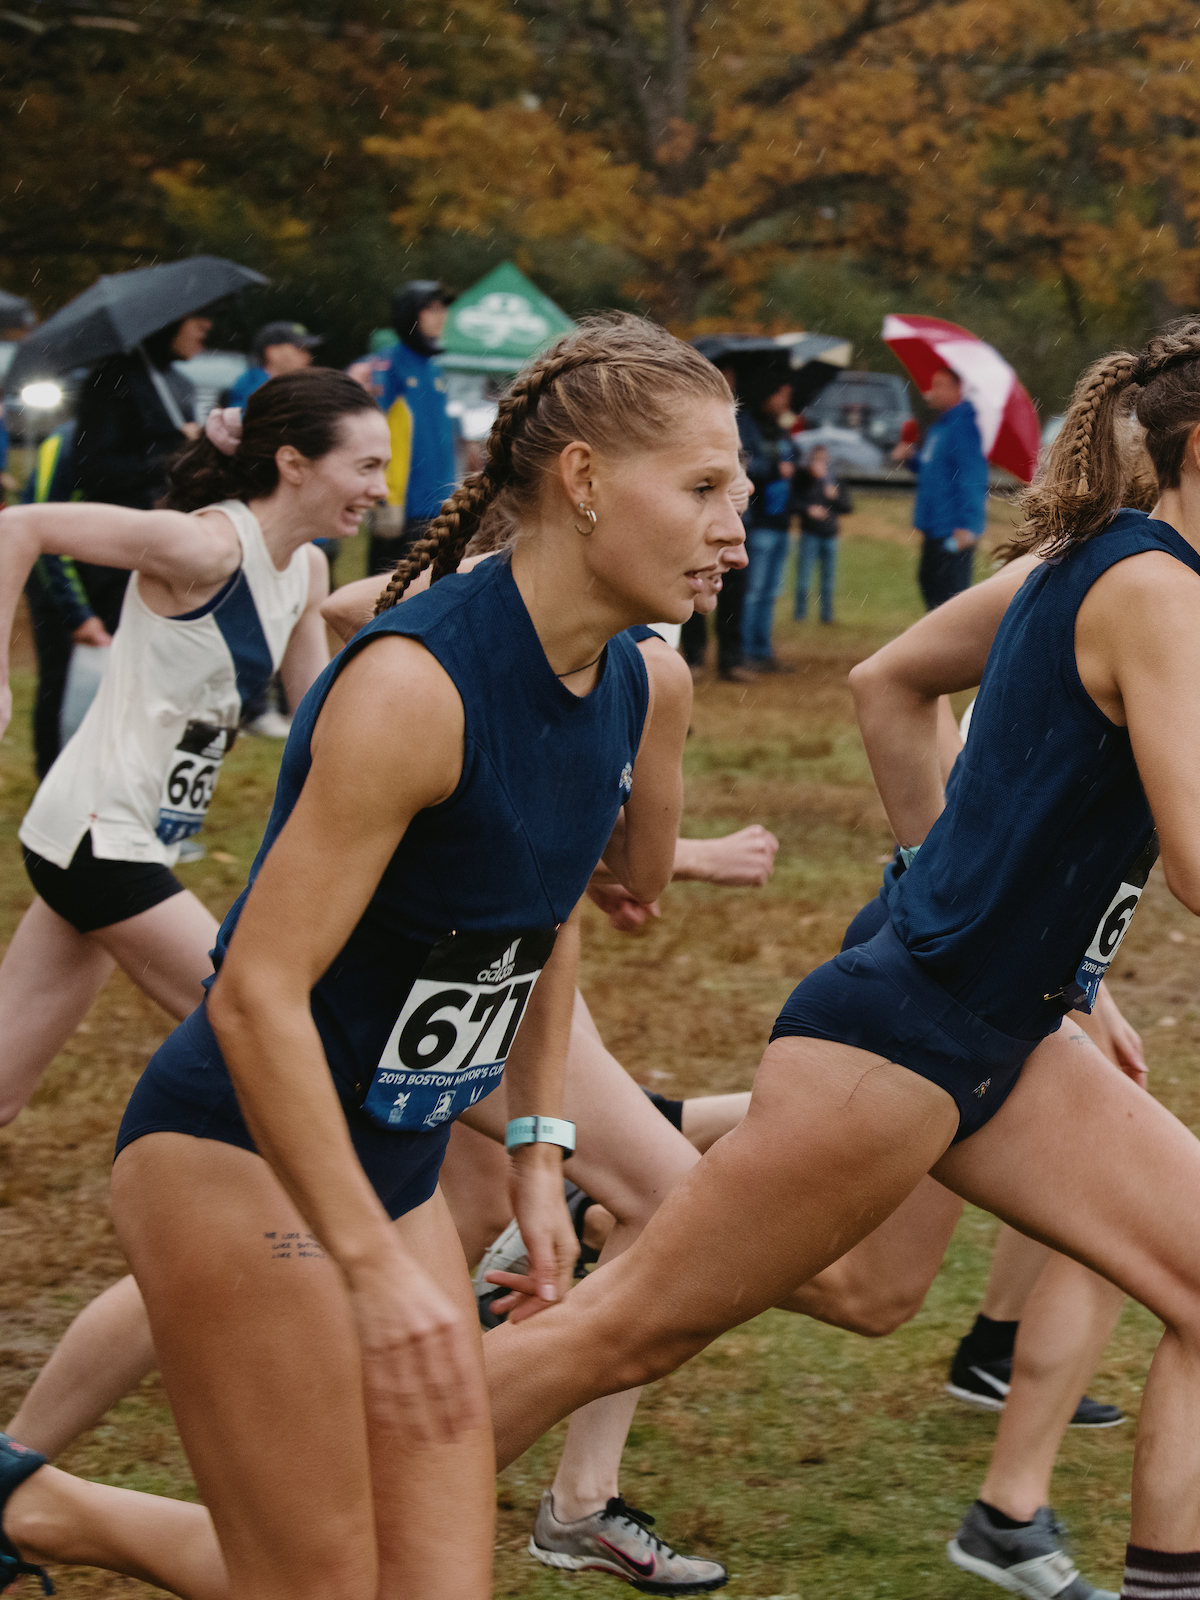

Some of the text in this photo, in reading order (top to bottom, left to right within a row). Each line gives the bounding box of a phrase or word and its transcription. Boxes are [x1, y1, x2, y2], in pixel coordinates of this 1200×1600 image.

[398, 979, 533, 1070] 671
[378, 1072, 406, 1084] 2019
[406, 1074, 453, 1087] BOSTON
[453, 1068, 488, 1086] MAYOR'S
